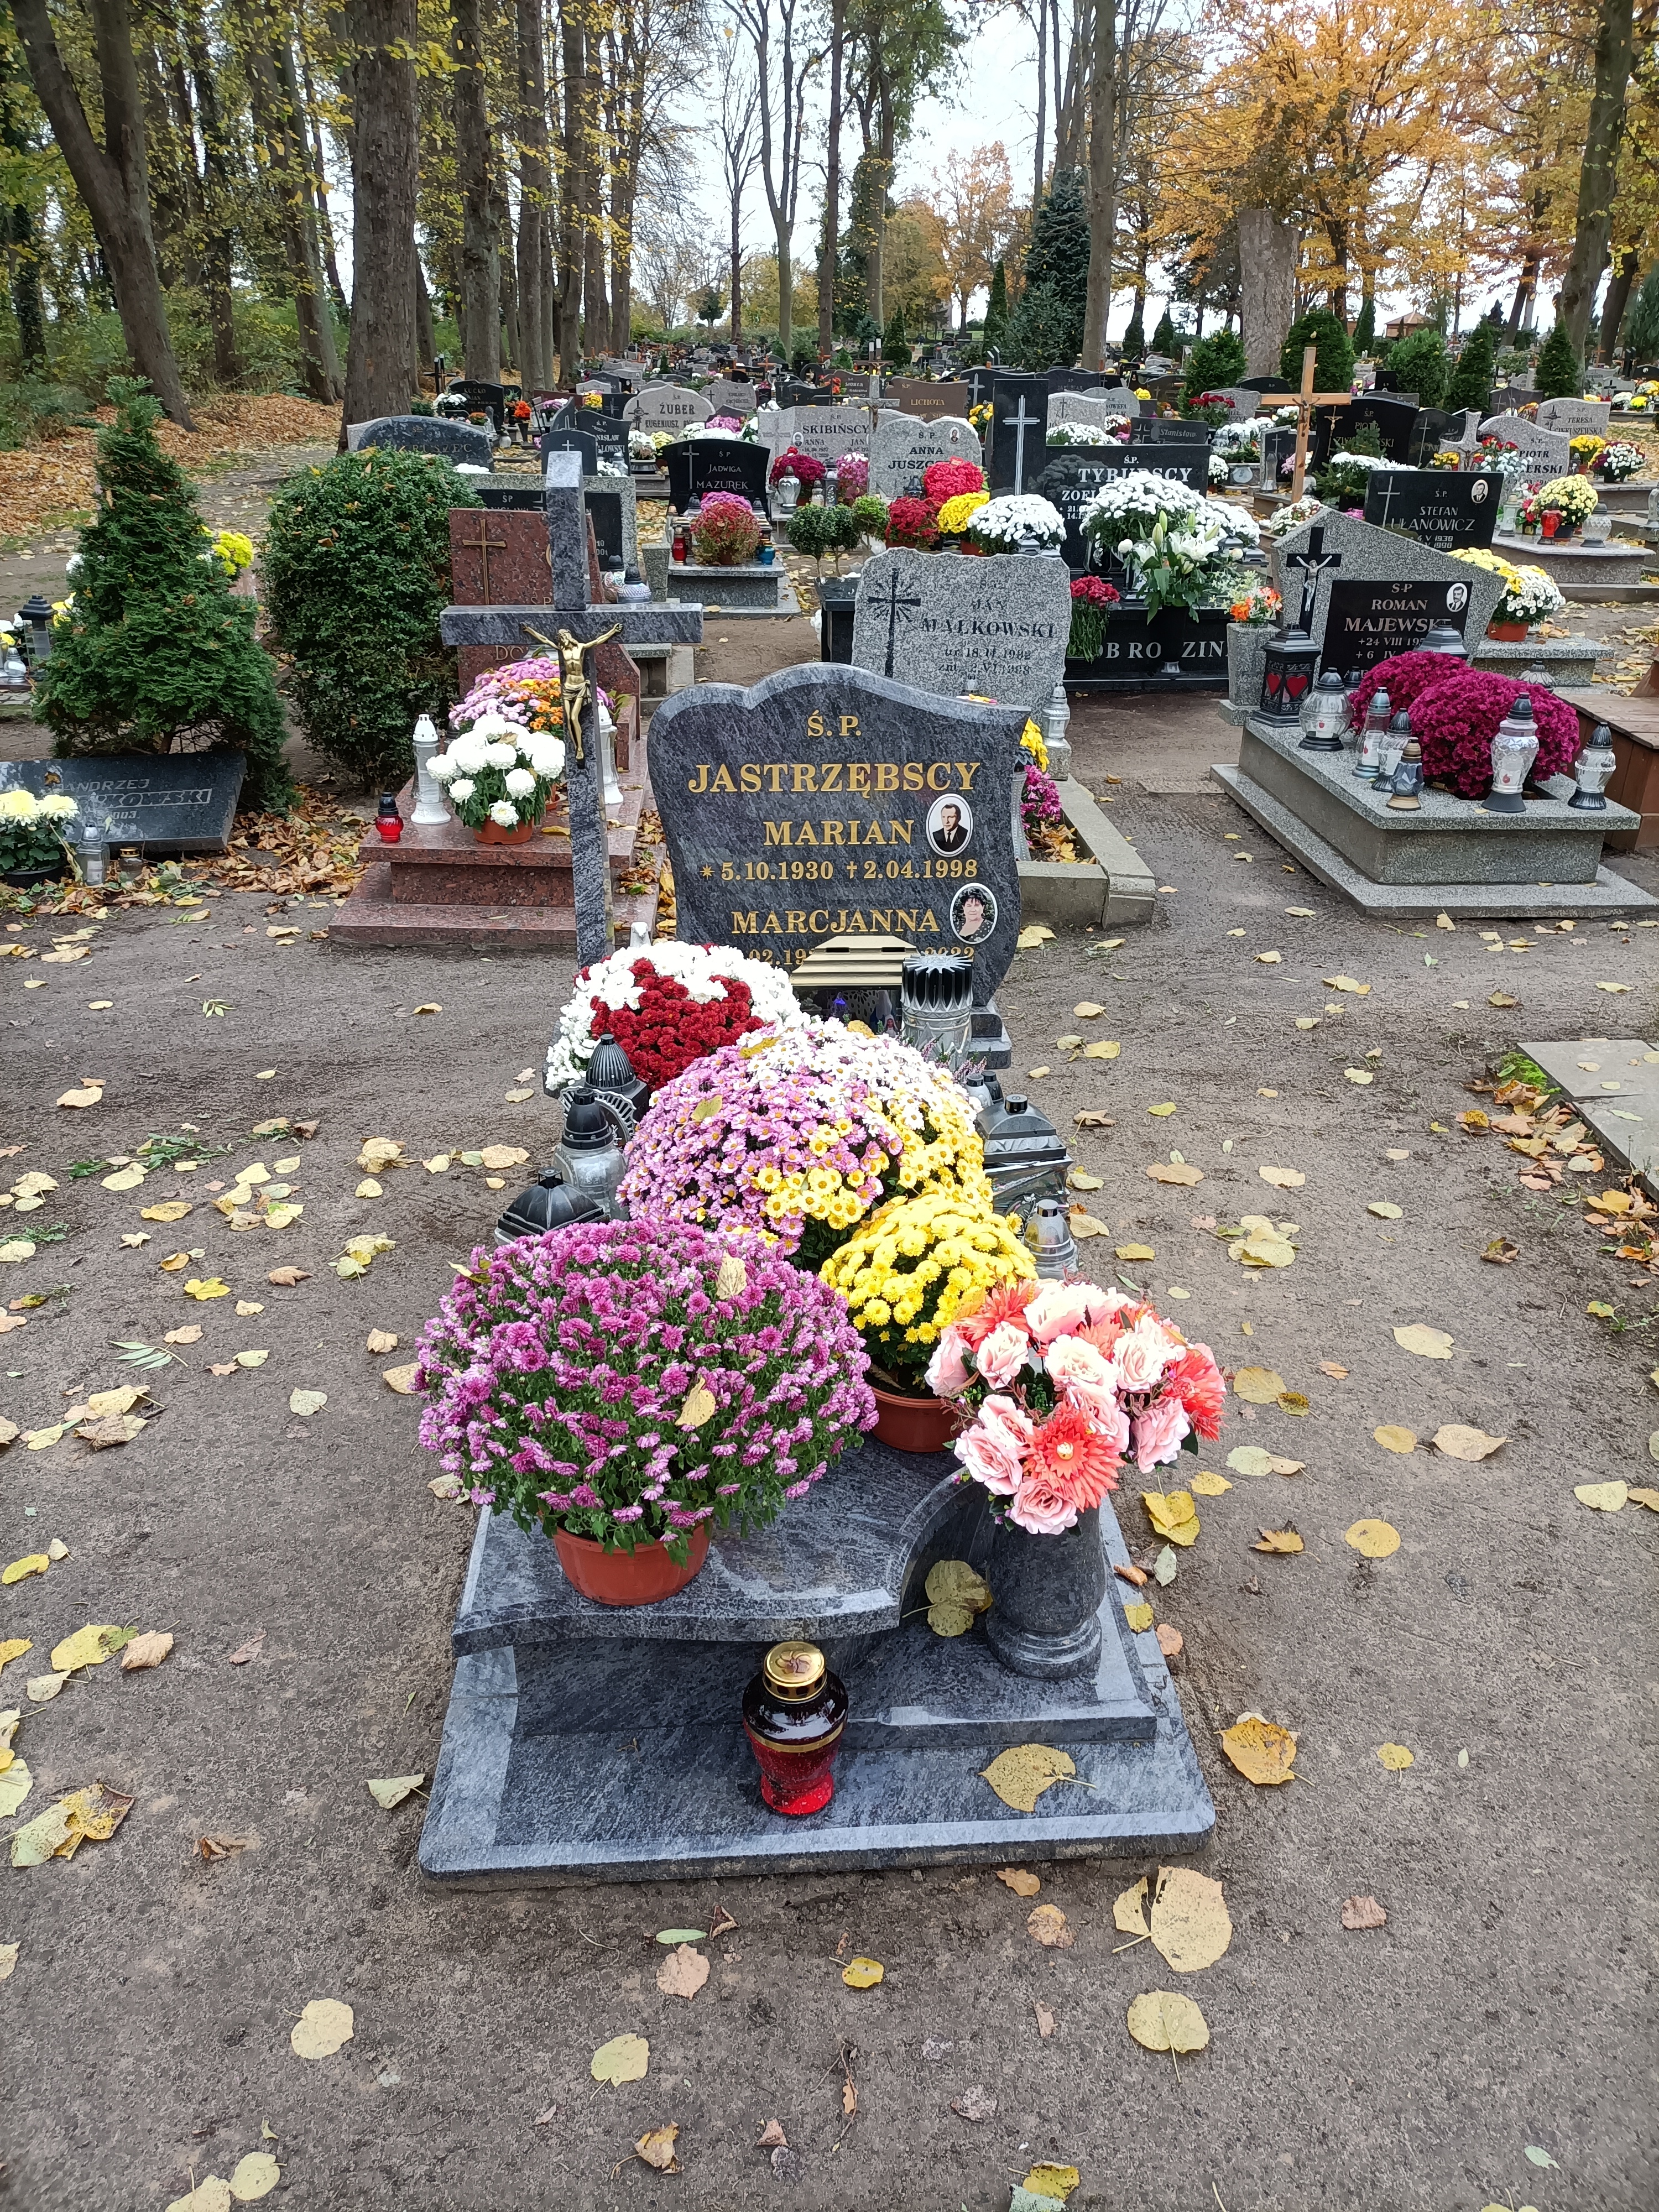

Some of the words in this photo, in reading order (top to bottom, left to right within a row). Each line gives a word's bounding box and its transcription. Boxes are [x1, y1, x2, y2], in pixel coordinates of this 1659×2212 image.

[659, 401, 696, 415] ŻUBER
[645, 419, 679, 428] EUGENIUSZ
[802, 423, 870, 434] SKIBIŃSCY
[1519, 450, 1550, 458] PIOTR
[706, 464, 742, 474] JADWIGA
[1524, 465, 1563, 474] ERSKI
[1078, 468, 1193, 483] TYBSCY
[696, 480, 749, 491] MAZUREK
[1061, 490, 1096, 501] ZOFI
[1419, 506, 1458, 516] STEFAN
[1391, 518, 1475, 531] UŁANOWICZ
[1371, 599, 1428, 611] ROMAN
[1343, 617, 1440, 633] MAJEWSK
[1384, 637, 1402, 646] VIII
[1406, 638, 1425, 646] 195
[688, 761, 980, 799] JASTRZĘBSCY
[763, 820, 914, 846] MARIAN
[731, 909, 941, 935] MARCJANNA
